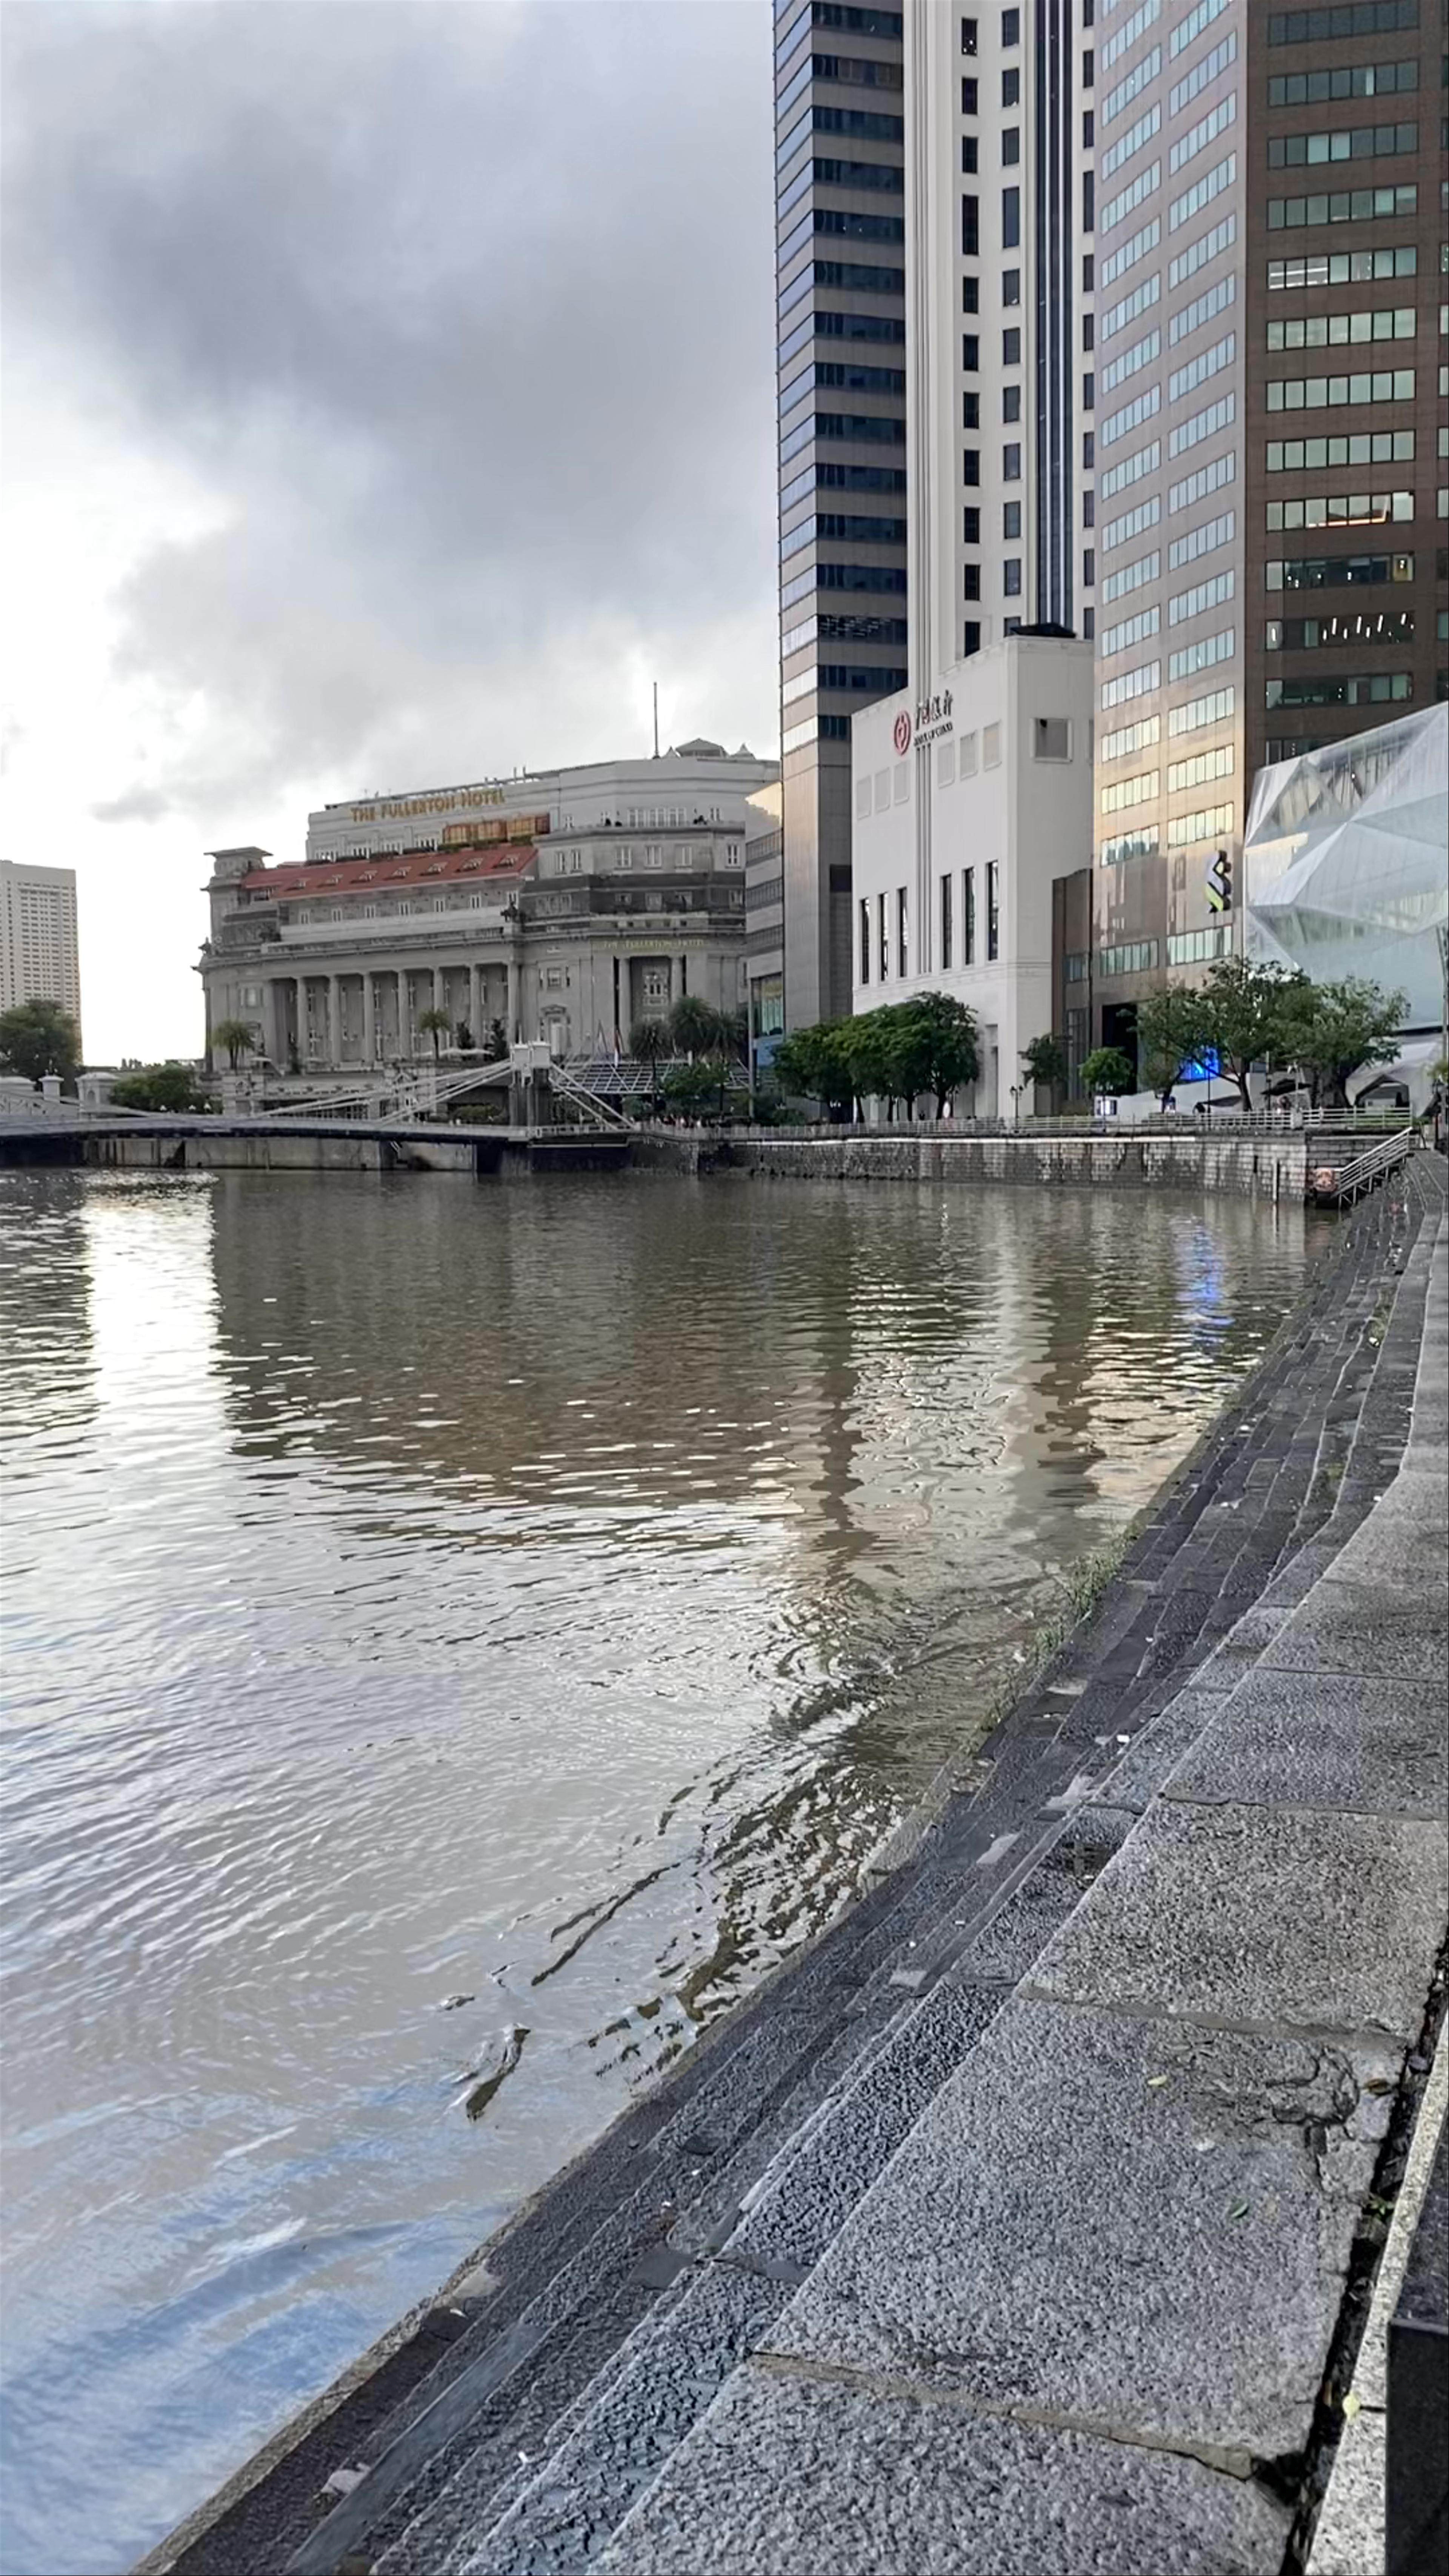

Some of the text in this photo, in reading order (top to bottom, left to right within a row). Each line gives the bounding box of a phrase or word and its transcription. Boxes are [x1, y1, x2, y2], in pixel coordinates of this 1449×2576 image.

[350, 787, 505, 822] THE FULLERTON HOTEL
